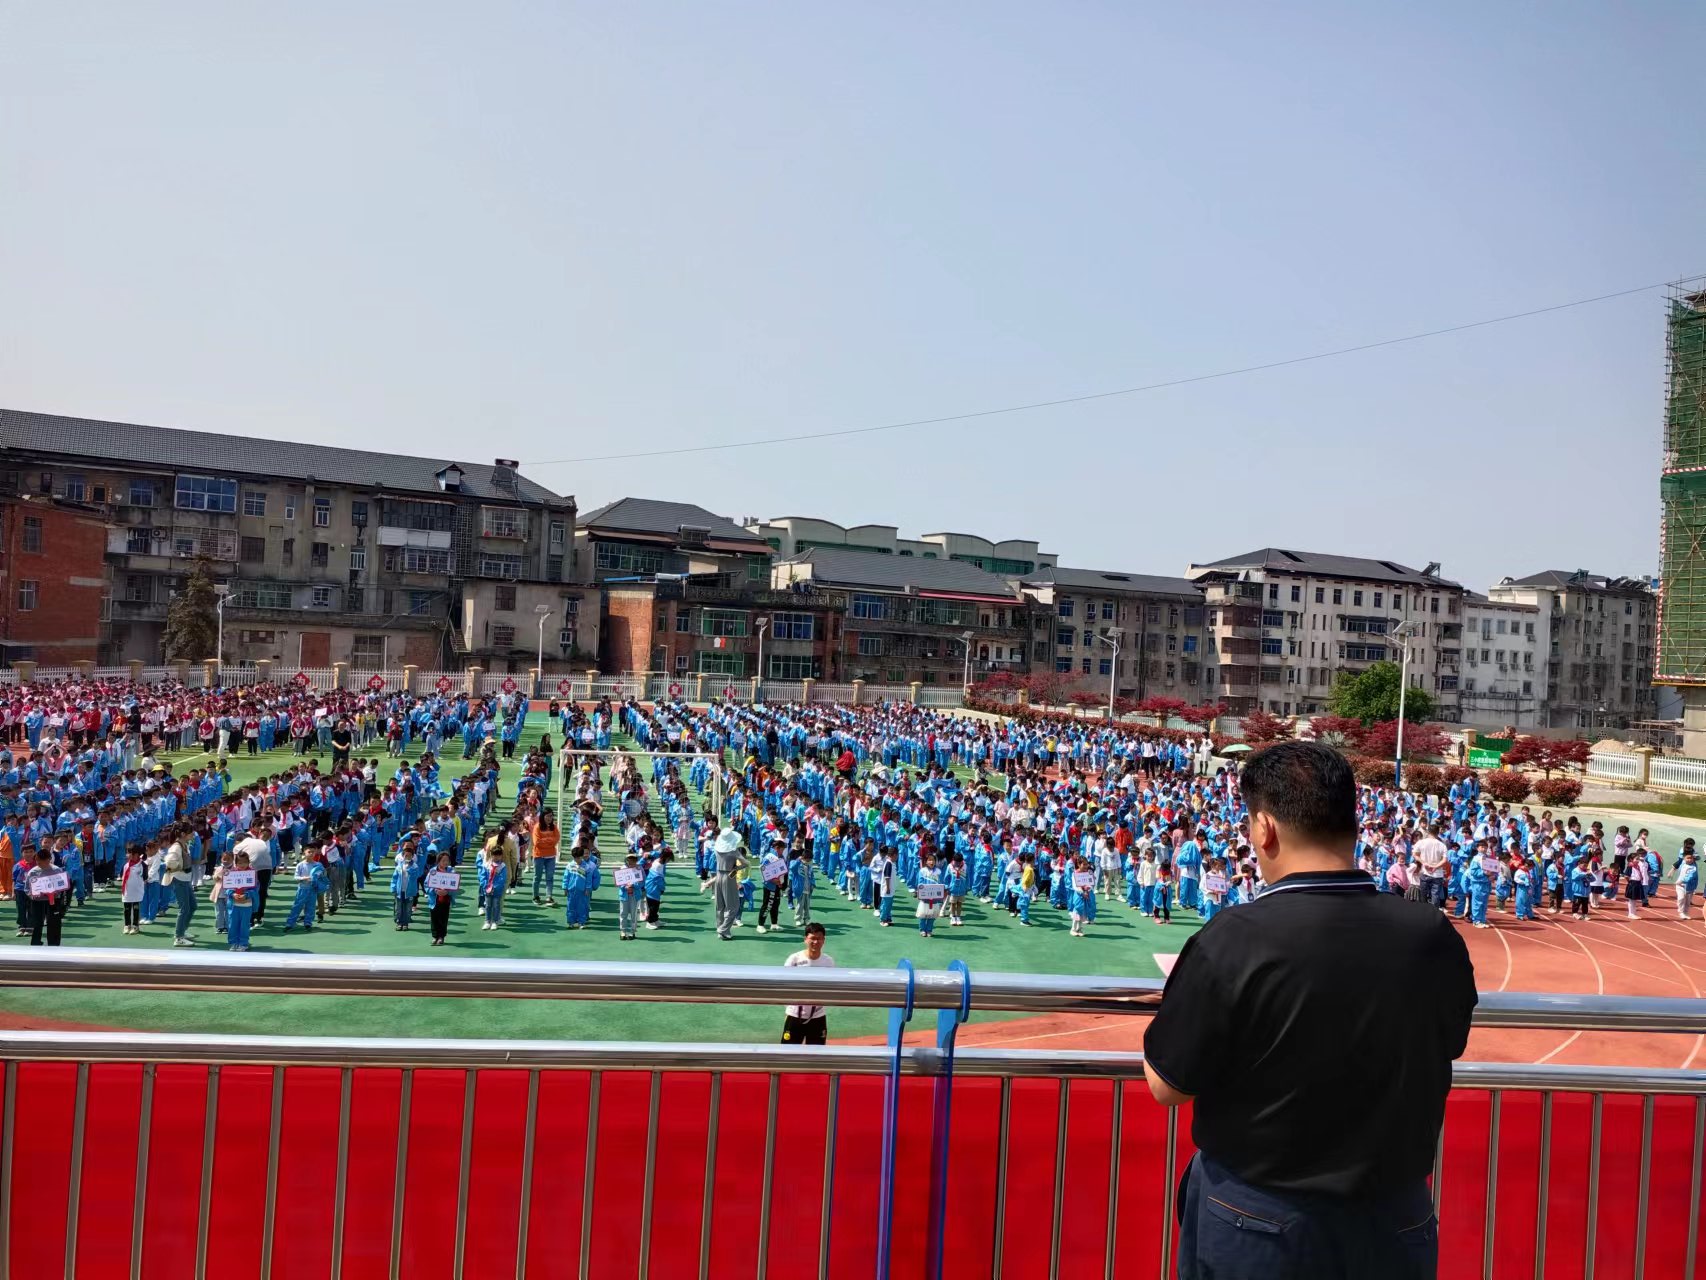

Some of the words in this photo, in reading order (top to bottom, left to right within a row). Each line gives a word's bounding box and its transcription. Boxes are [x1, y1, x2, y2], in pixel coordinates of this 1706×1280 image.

[371, 679, 382, 689] 中
[440, 680, 449, 690] 华
[505, 682, 514, 691] 民
